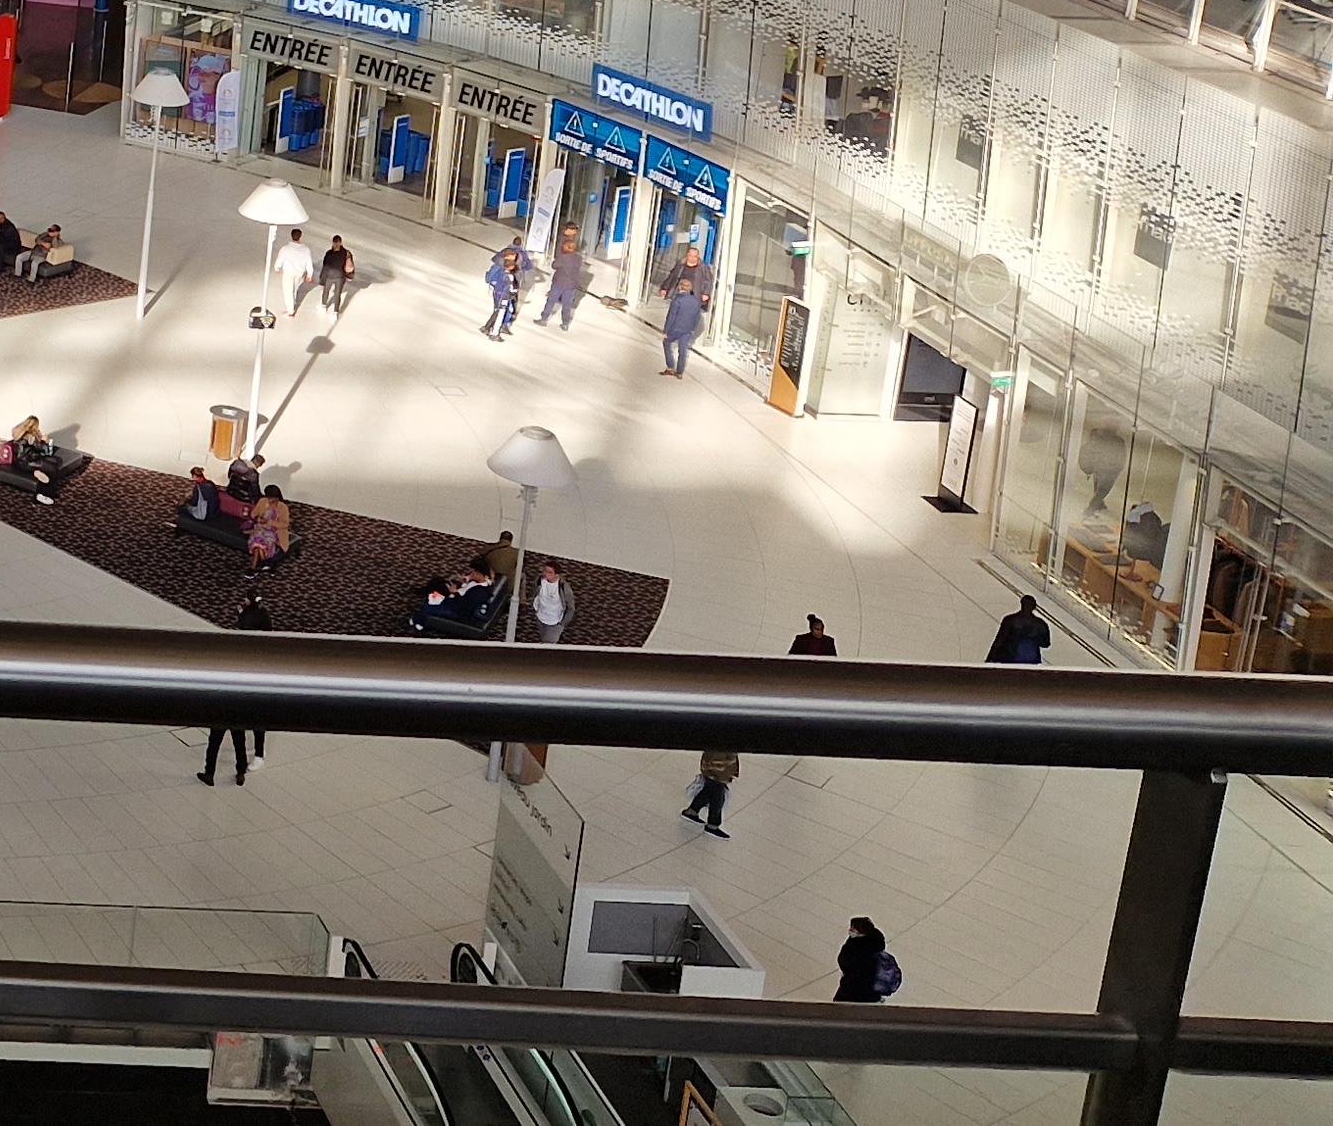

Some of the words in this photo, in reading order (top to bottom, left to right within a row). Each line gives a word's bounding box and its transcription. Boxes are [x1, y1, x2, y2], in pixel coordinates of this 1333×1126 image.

[250, 30, 333, 67] ENTRÉE
[355, 54, 436, 94] ENTRÉE
[458, 83, 538, 126] ENTRÉE
[597, 77, 705, 132] DECATHLON
[555, 132, 579, 151] SORTIE
[580, 141, 593, 154] DE
[595, 147, 634, 170] SPORTIFS
[648, 168, 673, 189] SORTIE
[673, 179, 684, 193] DE
[685, 186, 722, 211] SPORTIFS
